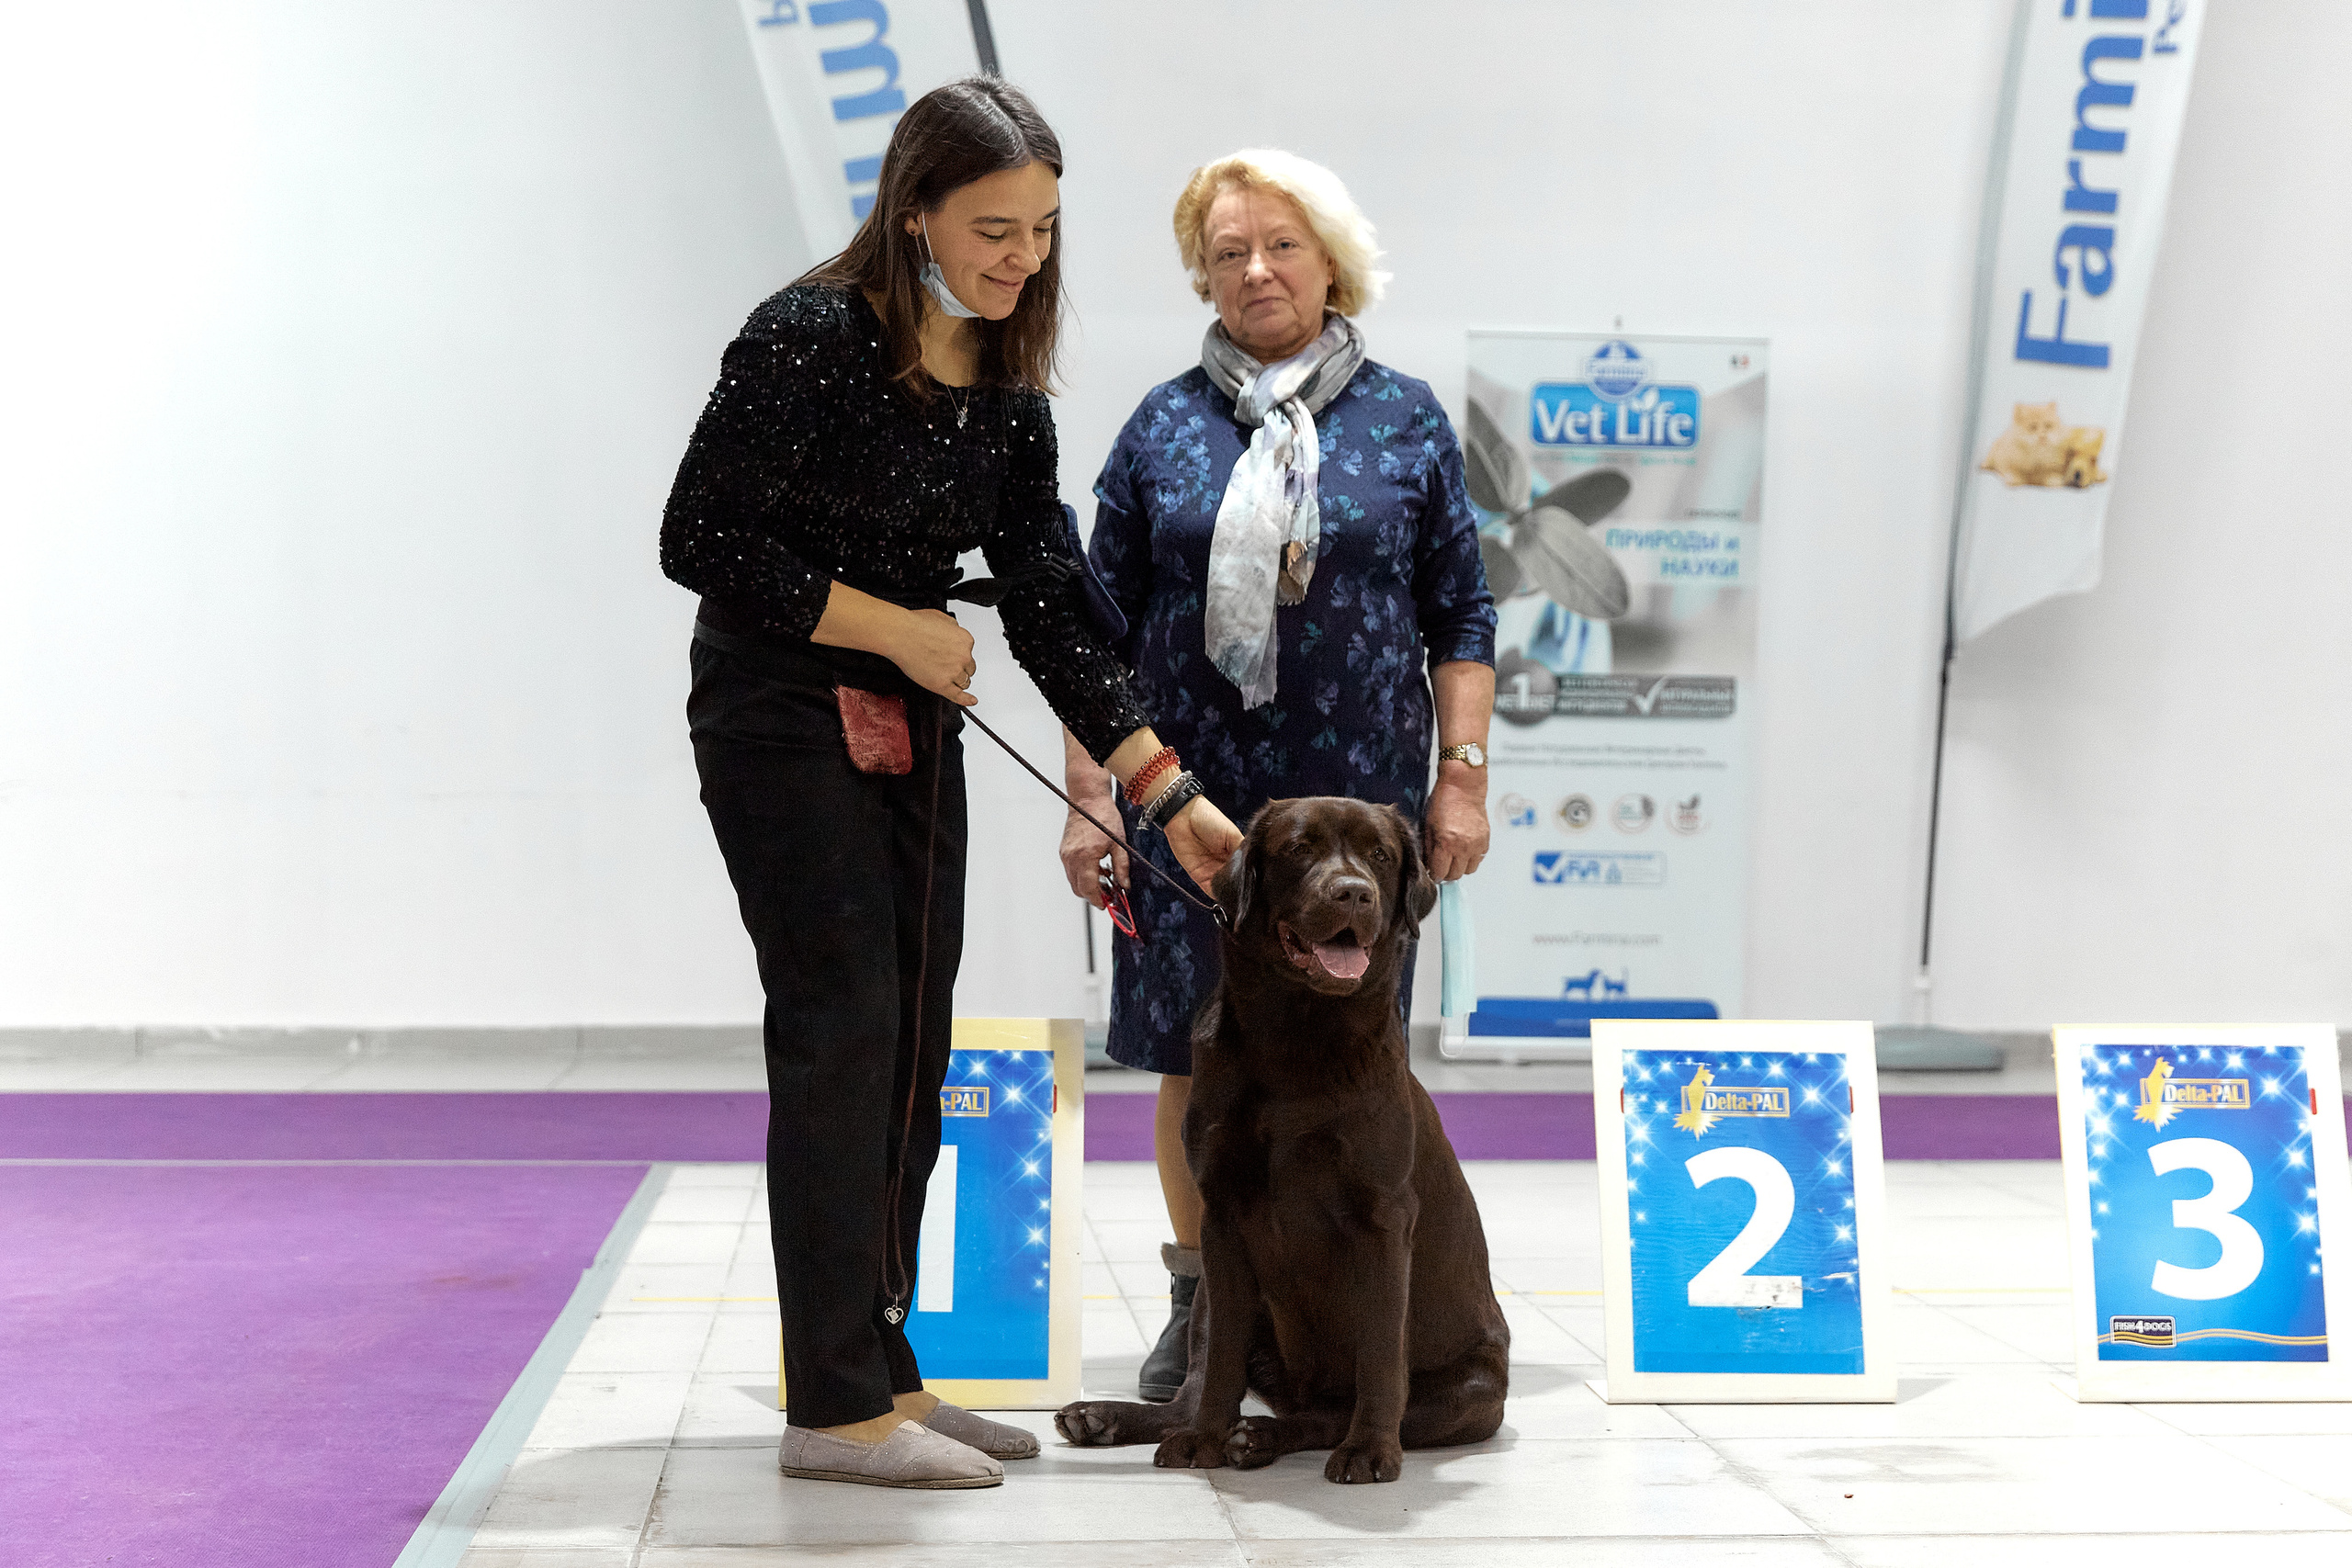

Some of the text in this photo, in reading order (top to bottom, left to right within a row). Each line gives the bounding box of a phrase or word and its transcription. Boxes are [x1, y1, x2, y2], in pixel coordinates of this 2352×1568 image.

[1535, 387, 1694, 446] Vet Life
[1705, 1092, 1782, 1111] Delta-PAL
[2164, 1084, 2244, 1102] Delta-PAL
[1684, 1146, 1804, 1308] 2
[2146, 1137, 2265, 1301] 3
